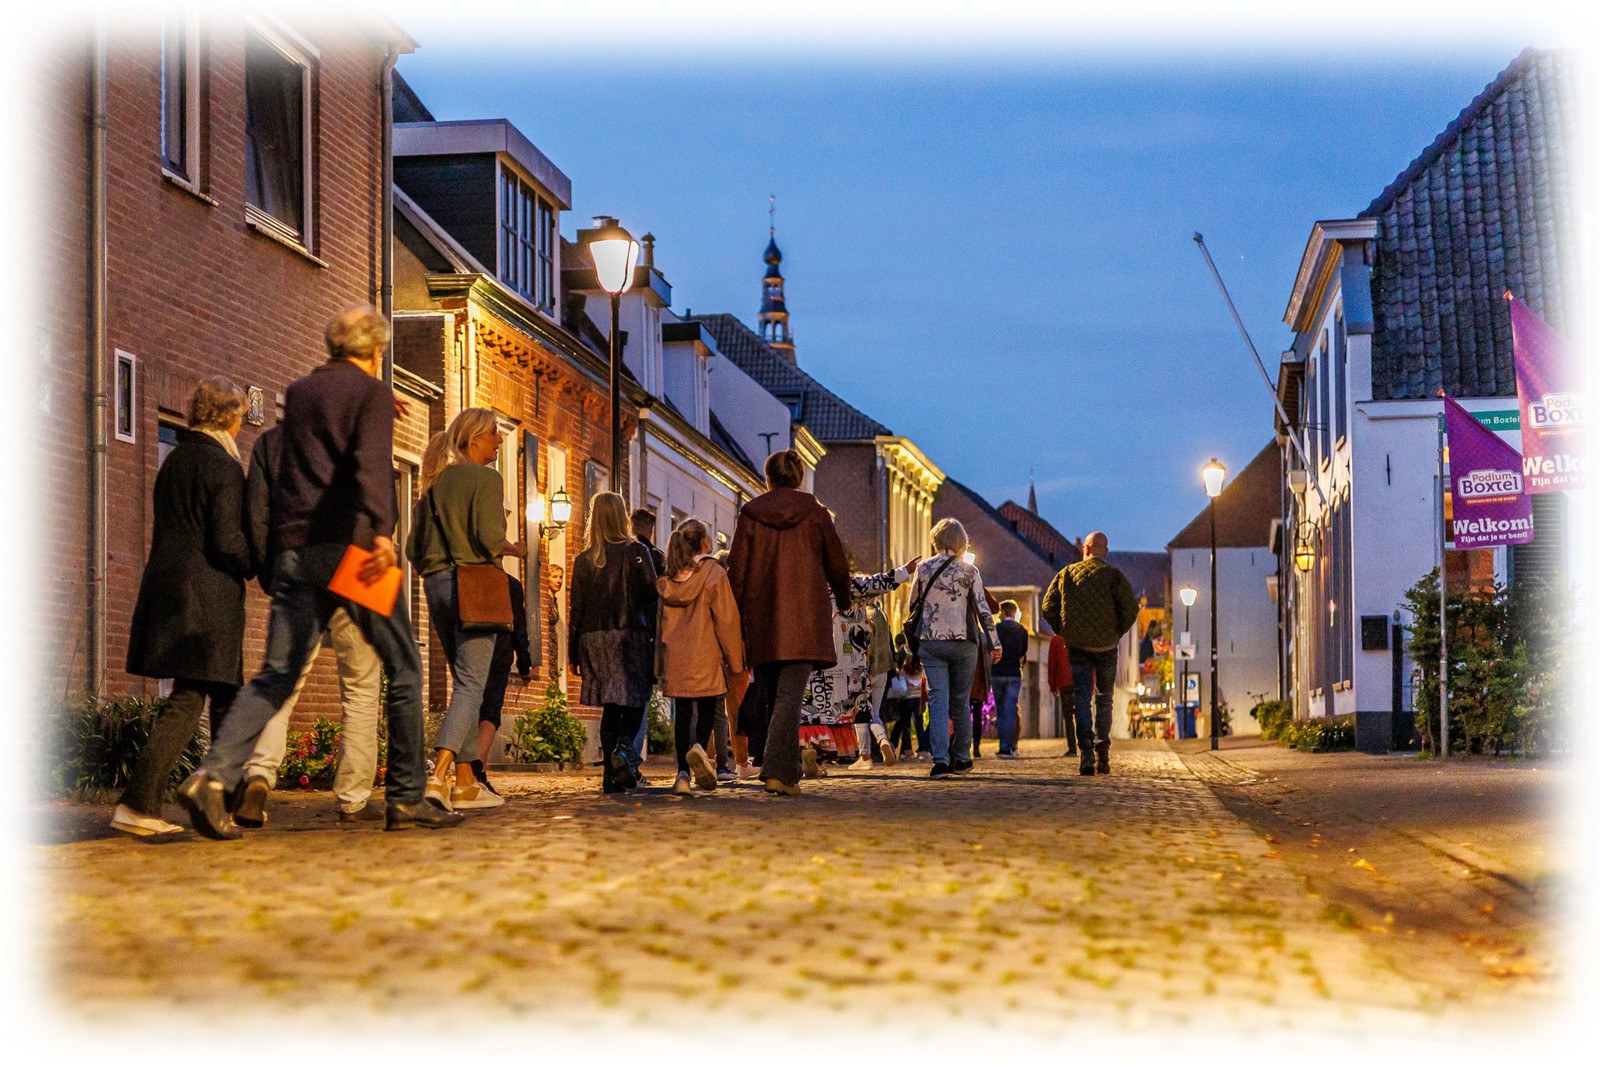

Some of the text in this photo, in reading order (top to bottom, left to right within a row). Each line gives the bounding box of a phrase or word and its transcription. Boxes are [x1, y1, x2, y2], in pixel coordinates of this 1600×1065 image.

[1546, 397, 1586, 408] Podiu
[1493, 415, 1520, 424] Boxtel
[1533, 406, 1586, 423] Boxt
[1472, 473, 1512, 482] Podium
[1532, 477, 1551, 486] Fijn
[1552, 475, 1568, 484] dat
[1461, 476, 1519, 494] Boxtel
[1453, 514, 1534, 535] Welkom!
[1490, 534, 1498, 542] je
